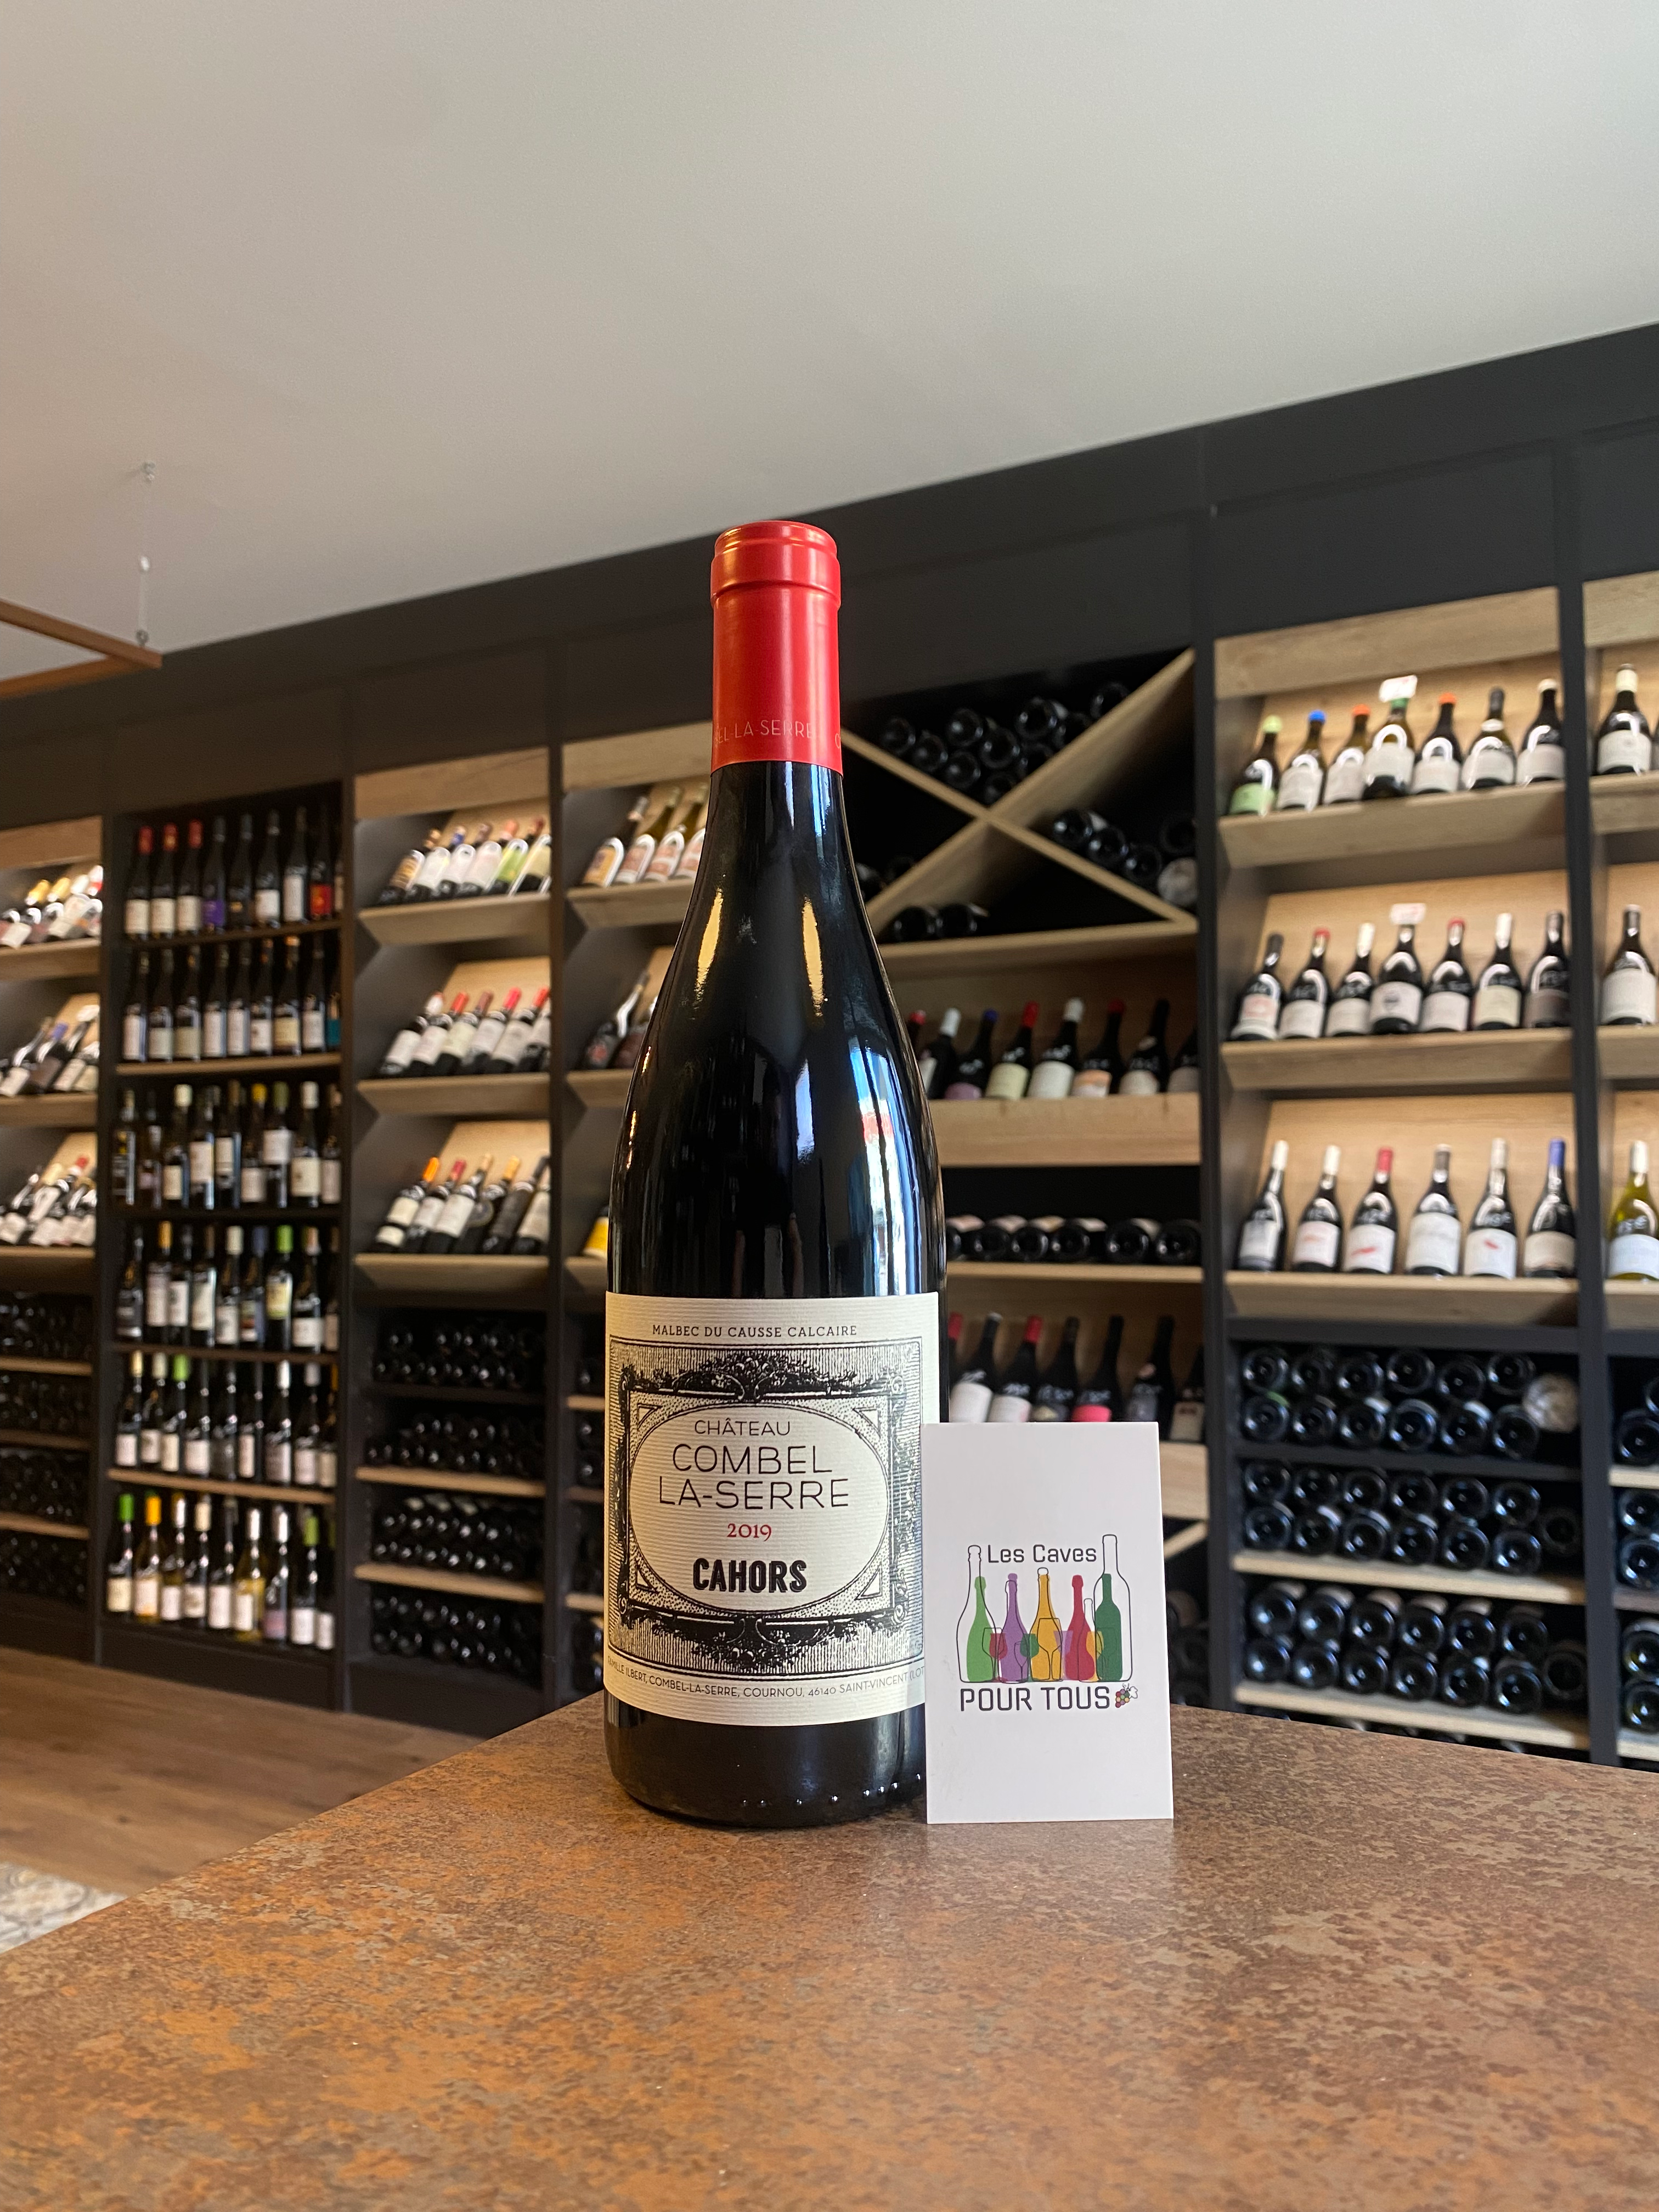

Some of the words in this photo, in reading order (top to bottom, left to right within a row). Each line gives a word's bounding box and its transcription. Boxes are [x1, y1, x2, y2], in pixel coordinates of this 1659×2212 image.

[652, 1324, 699, 1337] MALBEC
[704, 1327, 722, 1337] DU
[728, 1328, 781, 1338] CAUSSE
[788, 1325, 857, 1337] CALCAIRE
[695, 1419, 790, 1436] CHÂTEAU
[673, 1443, 832, 1475] COMBEL
[659, 1476, 849, 1510] LA-SERRE
[727, 1523, 772, 1541] 2019
[988, 1544, 1024, 1563] Les
[1033, 1544, 1097, 1564] Caves
[693, 1558, 807, 1593] CAHORS
[649, 1675, 740, 1697] COMBEL-LA-SERRE,
[743, 1688, 805, 1697] COURNOU,
[808, 1688, 837, 1696] 46140
[839, 1672, 909, 1693] SAINT-VINCENT
[960, 1688, 1032, 1712] POUR
[1041, 1686, 1110, 1711] TOUS
